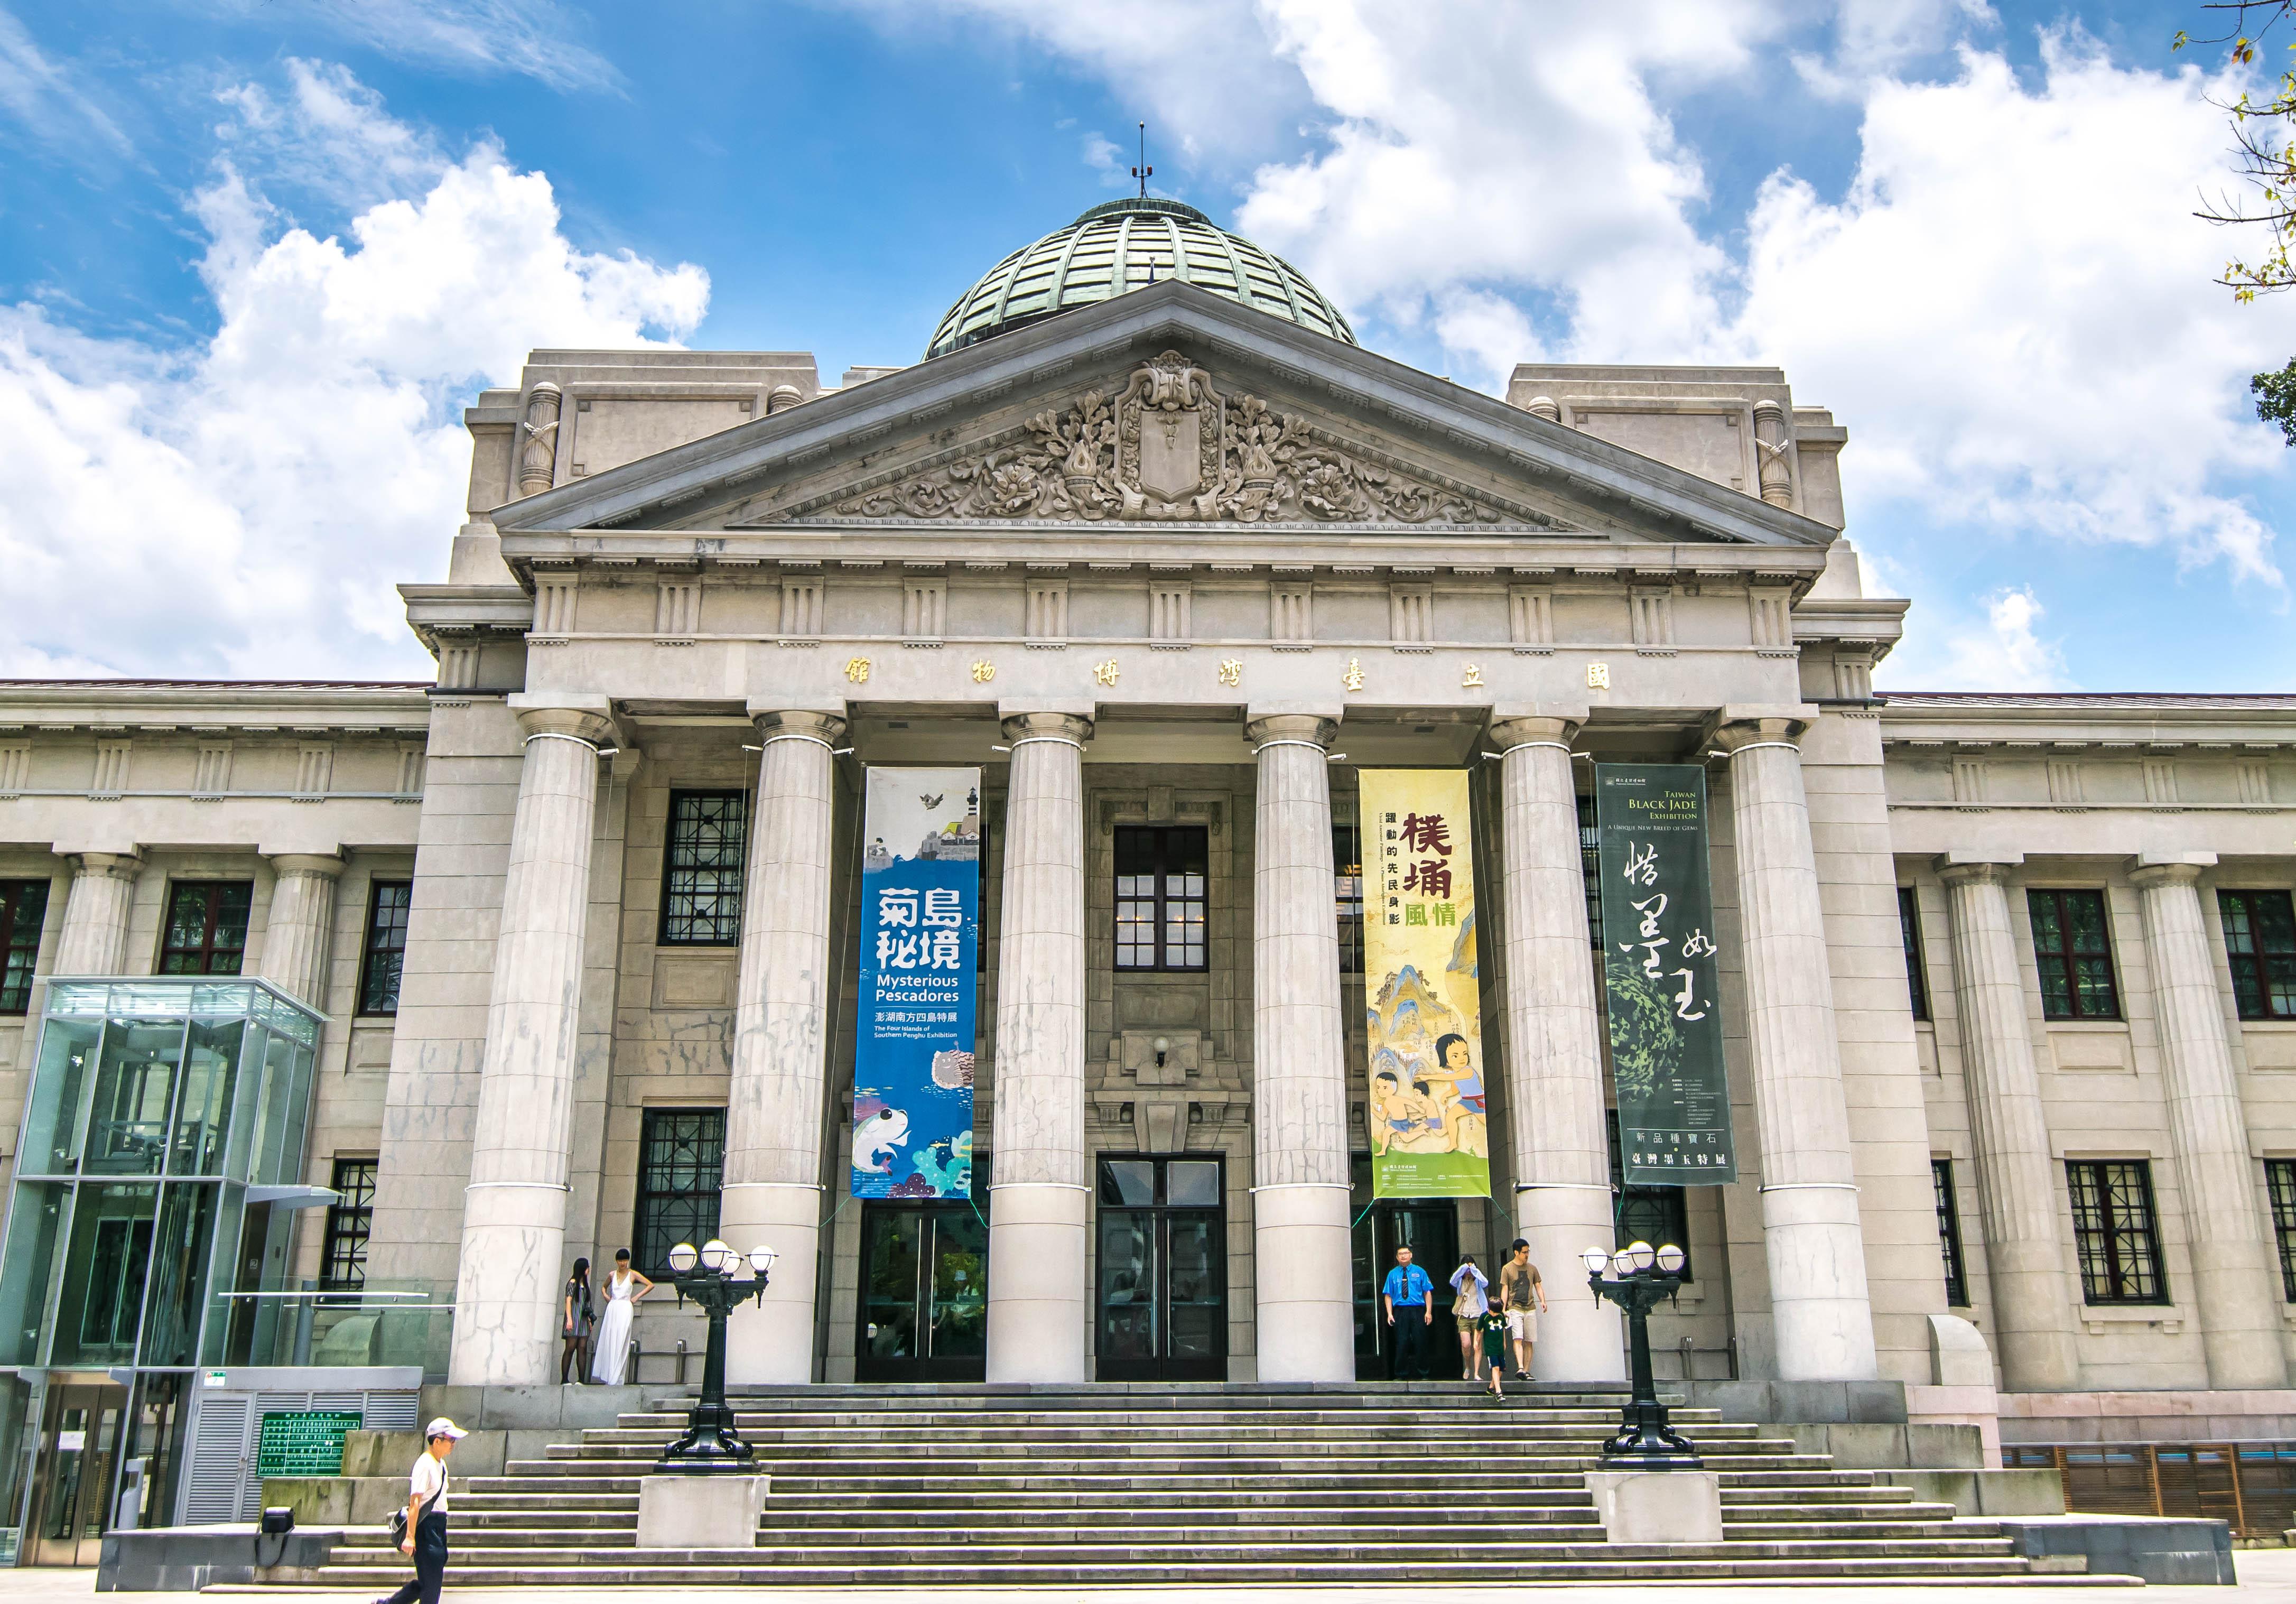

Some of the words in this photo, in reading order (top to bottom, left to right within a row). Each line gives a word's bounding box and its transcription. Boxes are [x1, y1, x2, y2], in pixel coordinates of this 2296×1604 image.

[1629, 799, 1666, 809] BLACK
[1670, 800, 1697, 811] JADE
[1386, 812, 1399, 925] 躍動的先民身影
[879, 888, 962, 928] 菊島
[1405, 903, 1456, 926] 風情
[876, 930, 961, 969] 秘境
[877, 973, 958, 990] Mysterious
[876, 989, 959, 1002] Pescadores
[875, 1012, 958, 1023] 澎湖南方四島特展
[1637, 1132, 1716, 1144] 新品種寶石
